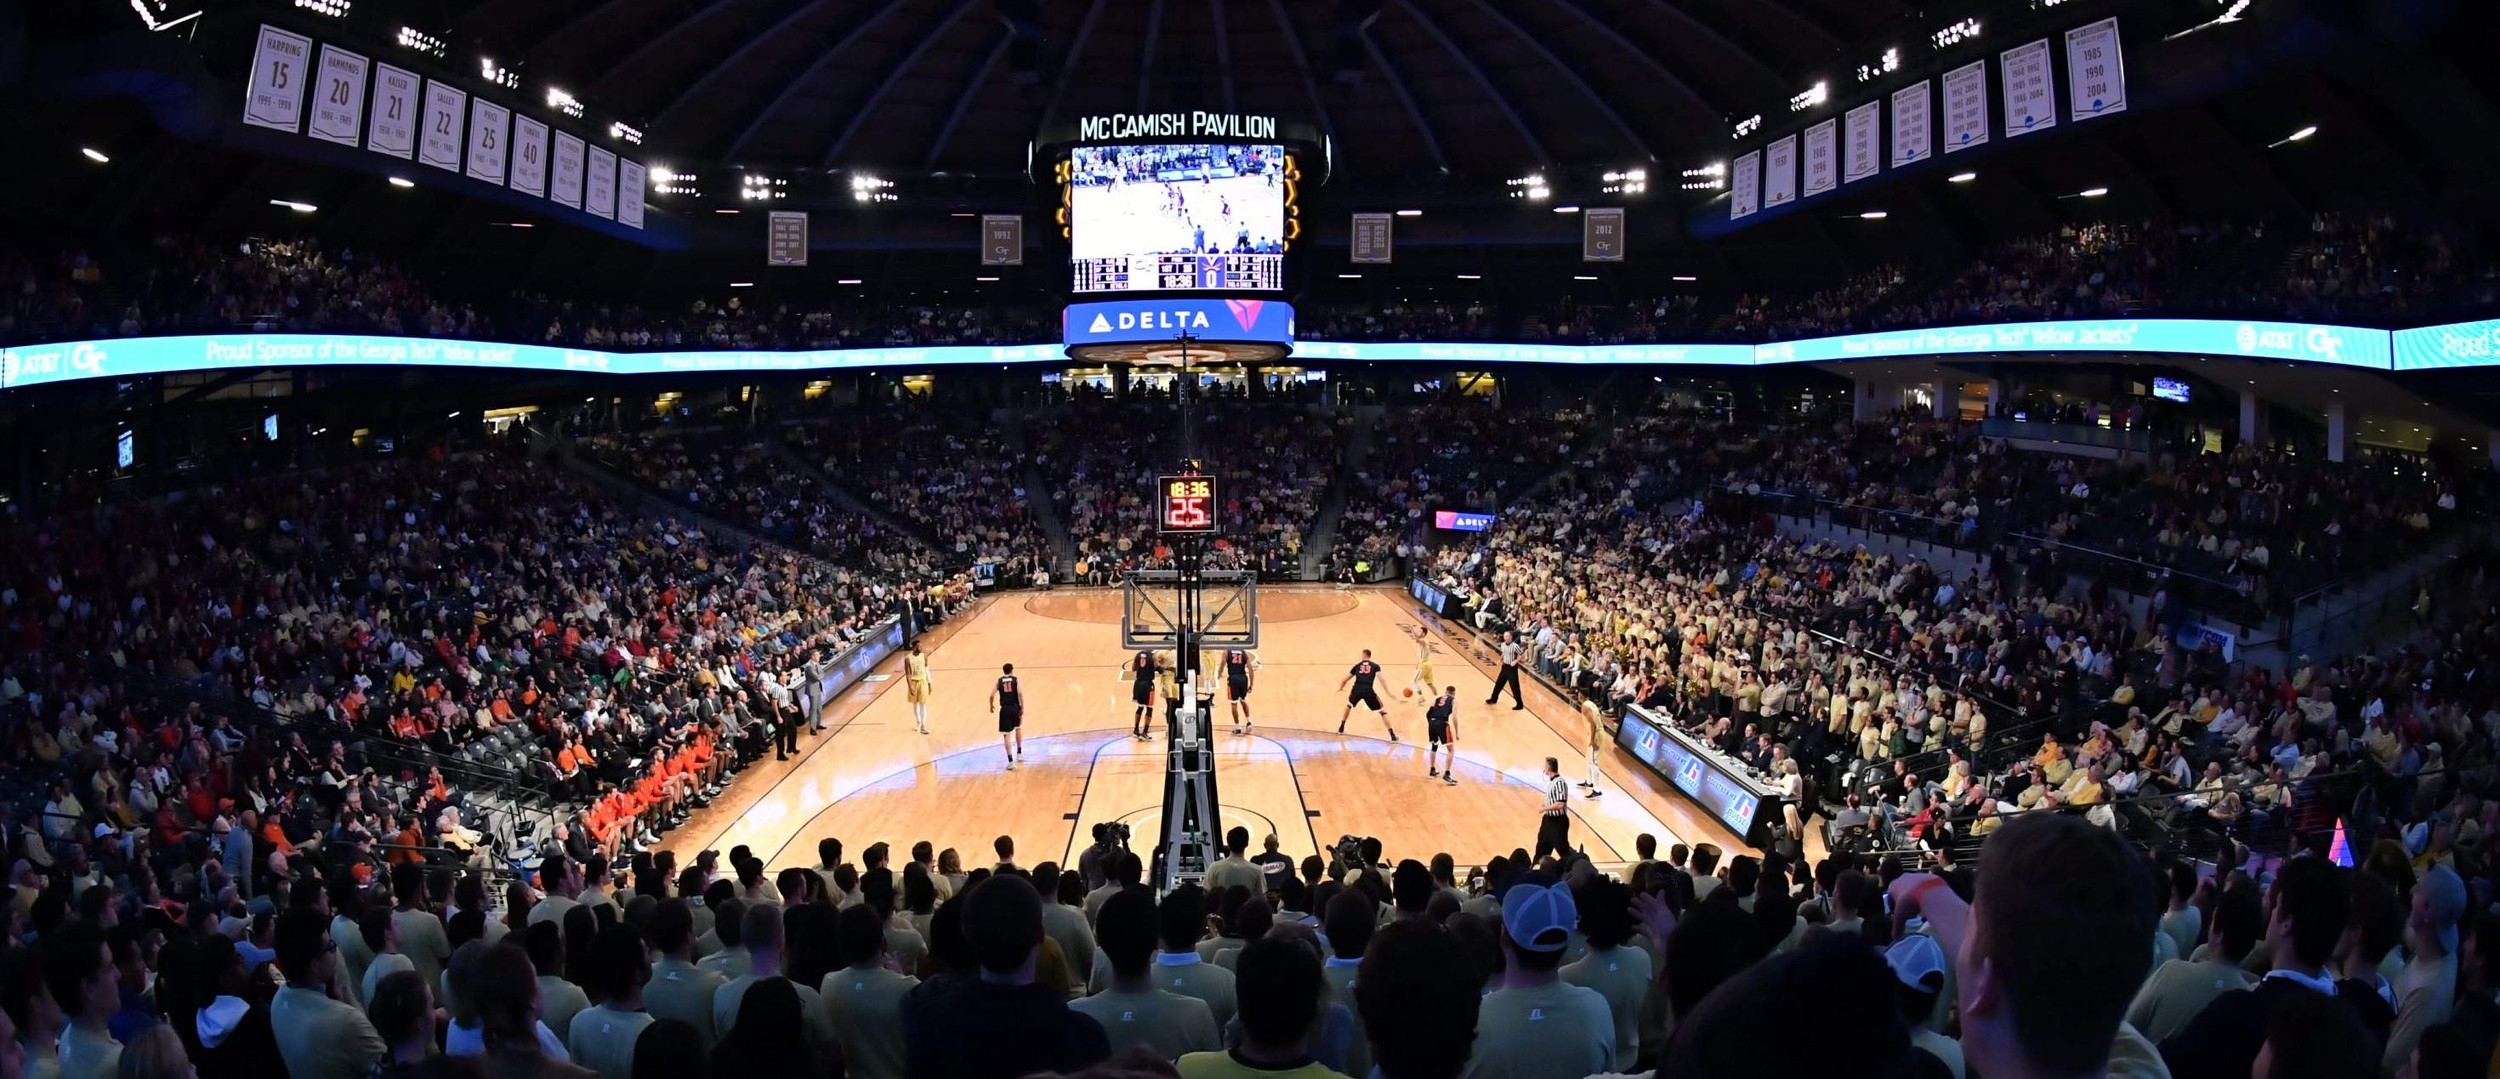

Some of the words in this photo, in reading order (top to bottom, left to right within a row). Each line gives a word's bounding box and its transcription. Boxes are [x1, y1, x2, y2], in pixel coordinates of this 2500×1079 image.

[267, 38, 301, 57] HARPRING
[2084, 47, 2102, 61] 1985
[272, 61, 289, 89] 15
[328, 57, 360, 75] HAMMONDS
[2086, 65, 2104, 79] 1990
[330, 78, 349, 106] 20
[388, 75, 408, 90] KAISER
[2087, 82, 2107, 98] 2004
[388, 96, 402, 121] 21
[437, 93, 455, 106] SALLEY
[436, 111, 451, 136] 22
[484, 109, 497, 123] PRICE
[1192, 111, 1275, 139] PAVILION
[482, 127, 496, 150] 25
[523, 142, 537, 165] 40
[1813, 146, 1826, 159] 1985
[1813, 161, 1826, 174] 1996
[994, 230, 1010, 240] 1992
[1595, 225, 1612, 235] 2012
[1164, 275, 1193, 289] 18:36
[1206, 270, 1217, 288] 0
[1119, 311, 1210, 330] DELTA
[1945, 331, 1991, 350] Georgia
[2032, 328, 2075, 345] Yellow
[2259, 330, 2294, 349] AT&T
[2307, 327, 2342, 360] GT
[2442, 331, 2490, 358] Proud
[72, 343, 107, 373] GT
[206, 341, 252, 361] Proud
[256, 340, 314, 364] Sponsor
[317, 340, 334, 358] of
[335, 340, 357, 358] the
[359, 340, 408, 363] Georgia
[443, 345, 474, 360] Yellow
[23, 353, 60, 374] AT&T
[1171, 481, 1210, 497] 18:36
[1171, 498, 1204, 525] 25
[1003, 682, 1012, 693] 11
